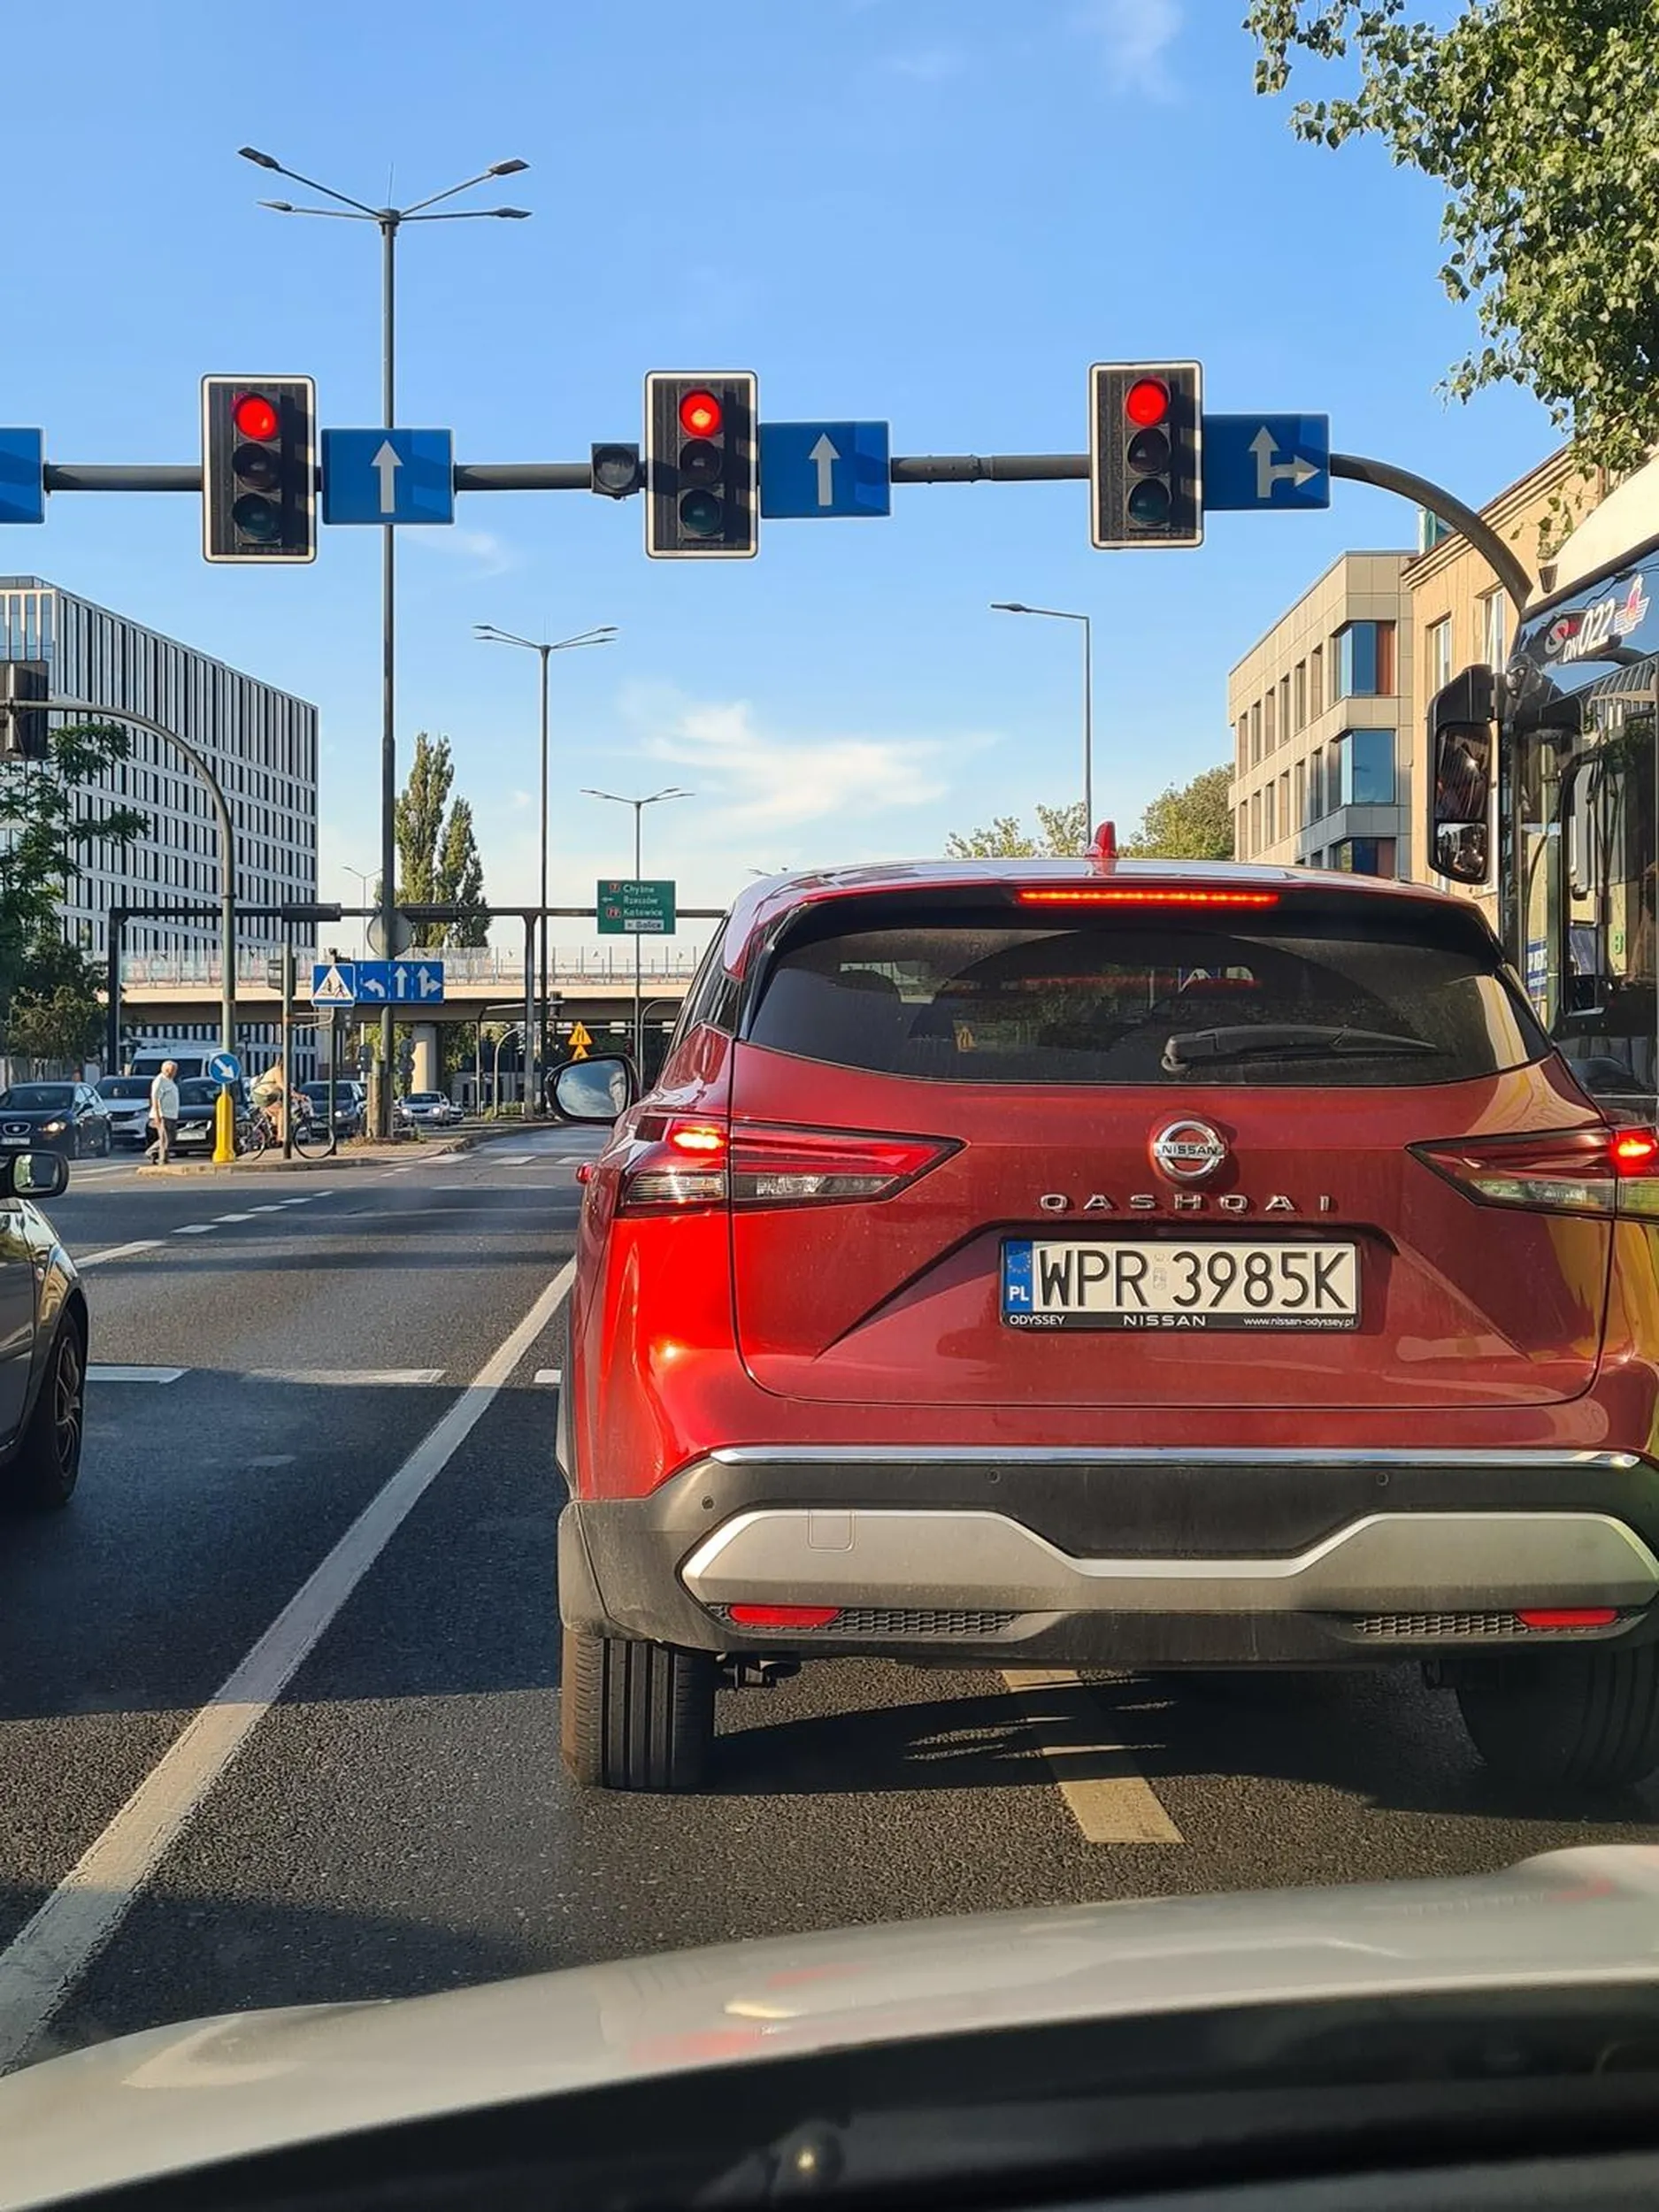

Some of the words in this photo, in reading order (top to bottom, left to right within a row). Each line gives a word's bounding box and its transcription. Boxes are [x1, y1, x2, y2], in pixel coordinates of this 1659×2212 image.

[623, 908, 664, 917] Katowice
[1161, 1144, 1218, 1156] NISSAN
[1041, 1194, 1331, 1213] QASHQAI
[1039, 1249, 1149, 1307] WPR
[1171, 1250, 1349, 1309] 3985K
[1009, 1286, 1029, 1302] PL
[1009, 1314, 1065, 1325] ODYSSEY
[1123, 1314, 1207, 1326] NISSAN
[1243, 1315, 1355, 1327] www.nissan-odyssey.pl
